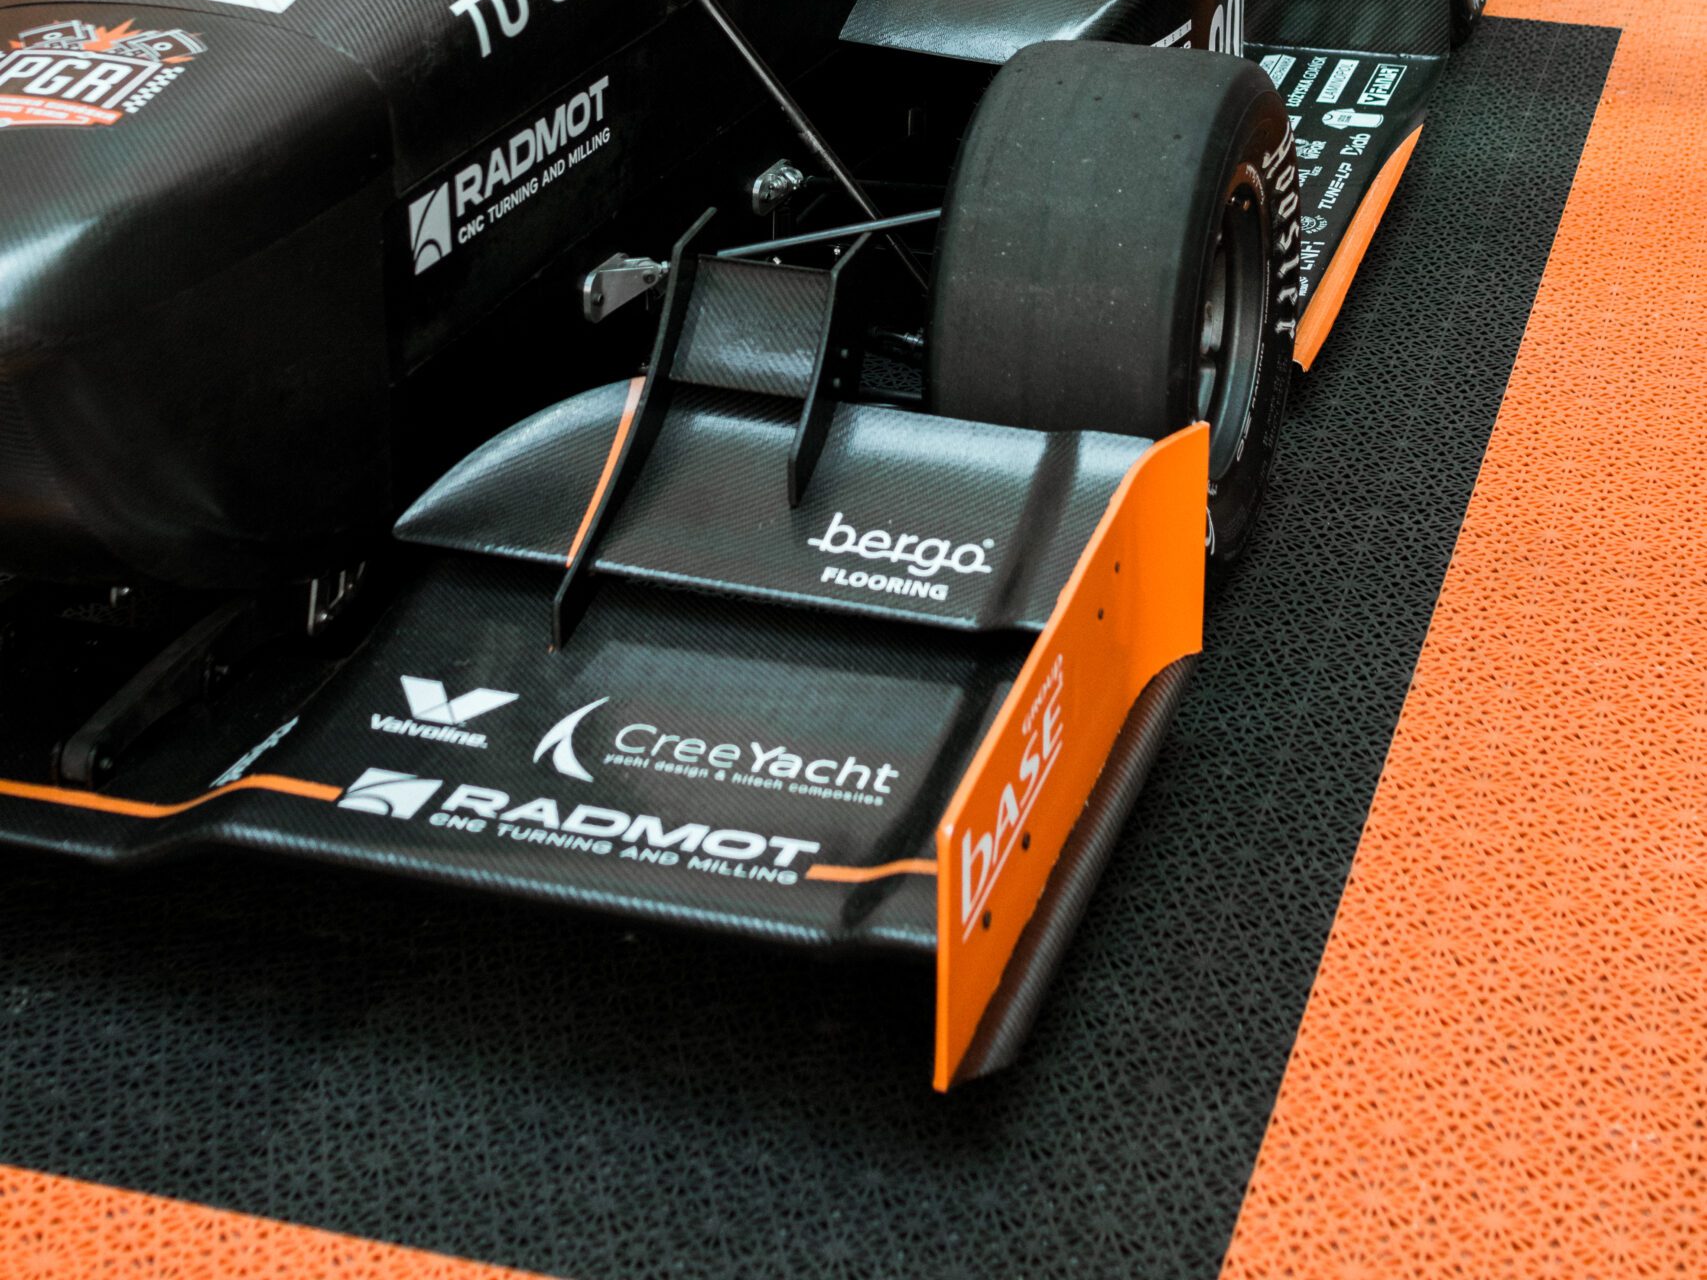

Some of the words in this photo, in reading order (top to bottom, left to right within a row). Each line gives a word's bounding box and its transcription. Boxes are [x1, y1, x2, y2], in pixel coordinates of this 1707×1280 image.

[0, 56, 134, 104] PGR
[454, 75, 609, 218] RADMOT
[457, 215, 485, 244] CNC
[487, 177, 539, 223] TURNING
[542, 159, 565, 187] AND
[568, 127, 611, 168] MILLING
[1317, 162, 1353, 210] TUNE-UP
[808, 512, 993, 577] bergo
[820, 566, 949, 601] FLOORING
[603, 752, 650, 769] yacht
[654, 760, 708, 779] design
[714, 769, 725, 781] &
[731, 771, 783, 791] hitech
[788, 782, 884, 807] composites
[429, 813, 487, 832] CNC
[498, 823, 612, 855] TURNING
[620, 845, 679, 866] AND
[688, 854, 799, 885] MILLING
[442, 784, 821, 867] RADMOT
